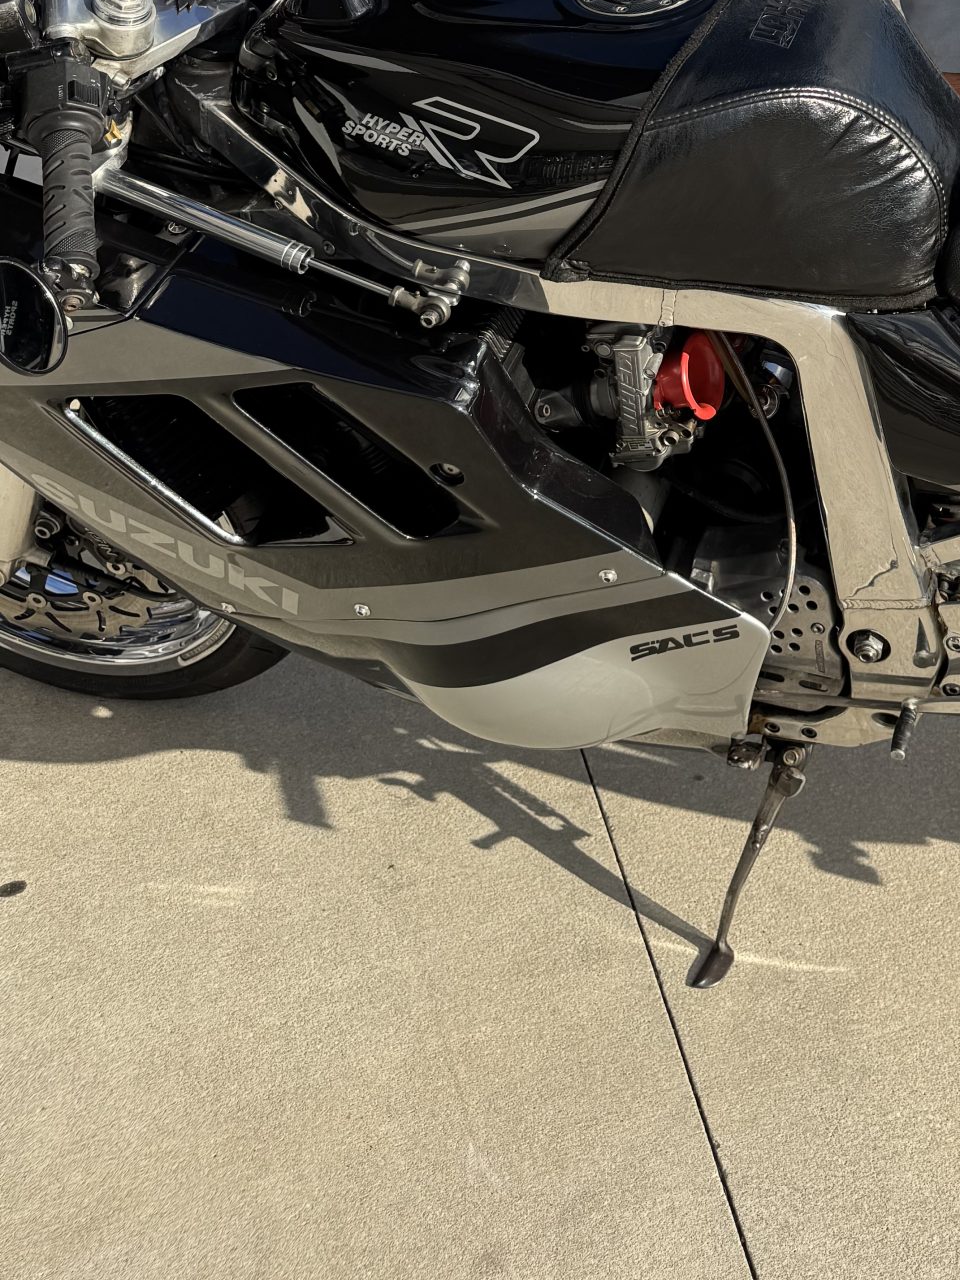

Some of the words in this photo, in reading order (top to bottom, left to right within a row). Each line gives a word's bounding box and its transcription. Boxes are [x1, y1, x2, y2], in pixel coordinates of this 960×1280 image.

[341, 119, 412, 157] SPORTS
[361, 113, 427, 146] HYPER
[30, 473, 299, 616] SUZUKI
[629, 623, 740, 662] SACS
